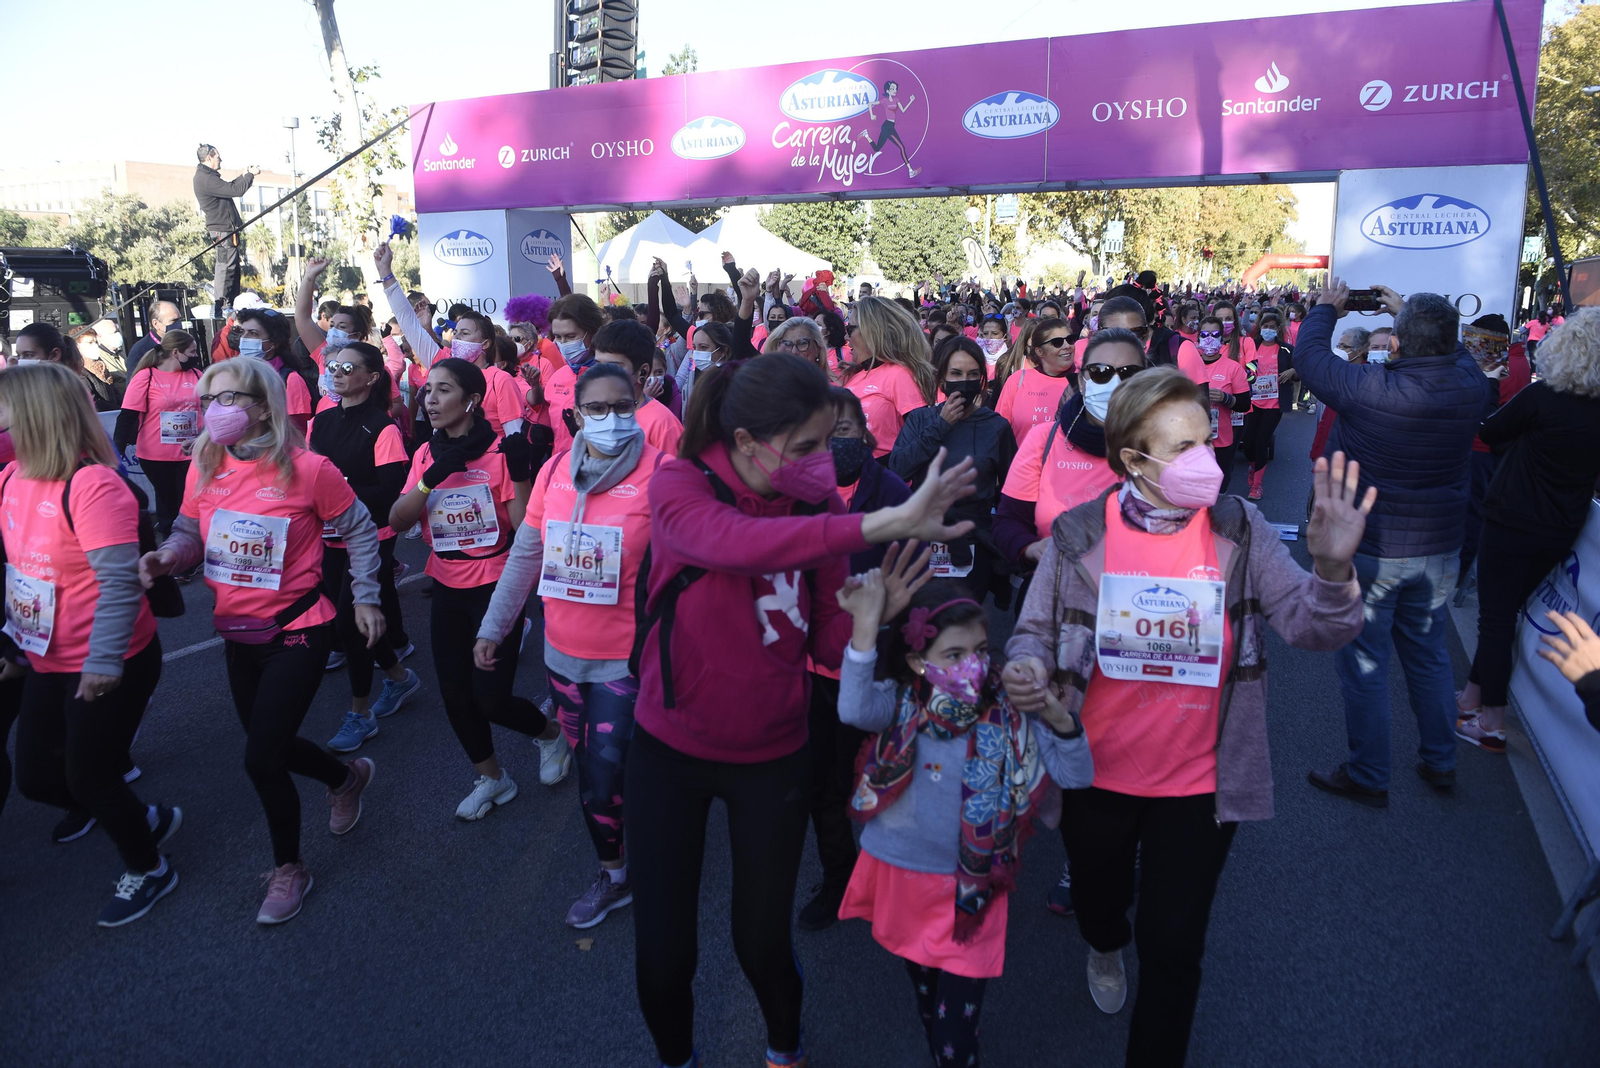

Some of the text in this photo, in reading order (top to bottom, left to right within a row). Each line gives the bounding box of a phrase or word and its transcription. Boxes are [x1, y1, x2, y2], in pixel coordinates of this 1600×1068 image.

[1402, 80, 1500, 103] ZURICH
[788, 92, 870, 112] ASTURIANA
[1017, 104, 1049, 112] LECHERA
[1092, 97, 1188, 122] OYSHO
[1221, 95, 1322, 116] Santander
[969, 110, 1052, 129] ASTURIANA
[771, 121, 852, 149] Carrera
[590, 138, 655, 159] OYSHO
[678, 134, 740, 152] ASTURIANA
[520, 146, 571, 162] ZURICH
[423, 157, 476, 172] Santander
[791, 140, 883, 187] de la Mujer
[1369, 215, 1480, 236] ASTURIANA
[439, 243, 490, 257] ASTURIANA
[524, 241, 562, 257] ASTURIANA
[1057, 460, 1093, 471] OYSHO
[553, 481, 578, 492] OYSH
[443, 499, 471, 507] ASTURIANA
[446, 511, 475, 525] 016
[232, 524, 264, 536] ASTURIANA
[229, 541, 263, 557] 016
[931, 543, 947, 554] 01
[31, 551, 51, 563] POR
[234, 557, 253, 566] 1989
[564, 553, 593, 570] 016
[568, 571, 584, 580] 2071
[542, 585, 565, 595] OYSHO
[13, 599, 31, 619] 016
[1136, 596, 1187, 609] ASTURIANA
[1135, 618, 1186, 639] 016
[1146, 642, 1172, 652] 1069
[1119, 650, 1152, 660] CARRERA
[1163, 653, 1174, 661] LA
[1175, 654, 1200, 663] MUJER
[1102, 663, 1138, 674] OYSHO
